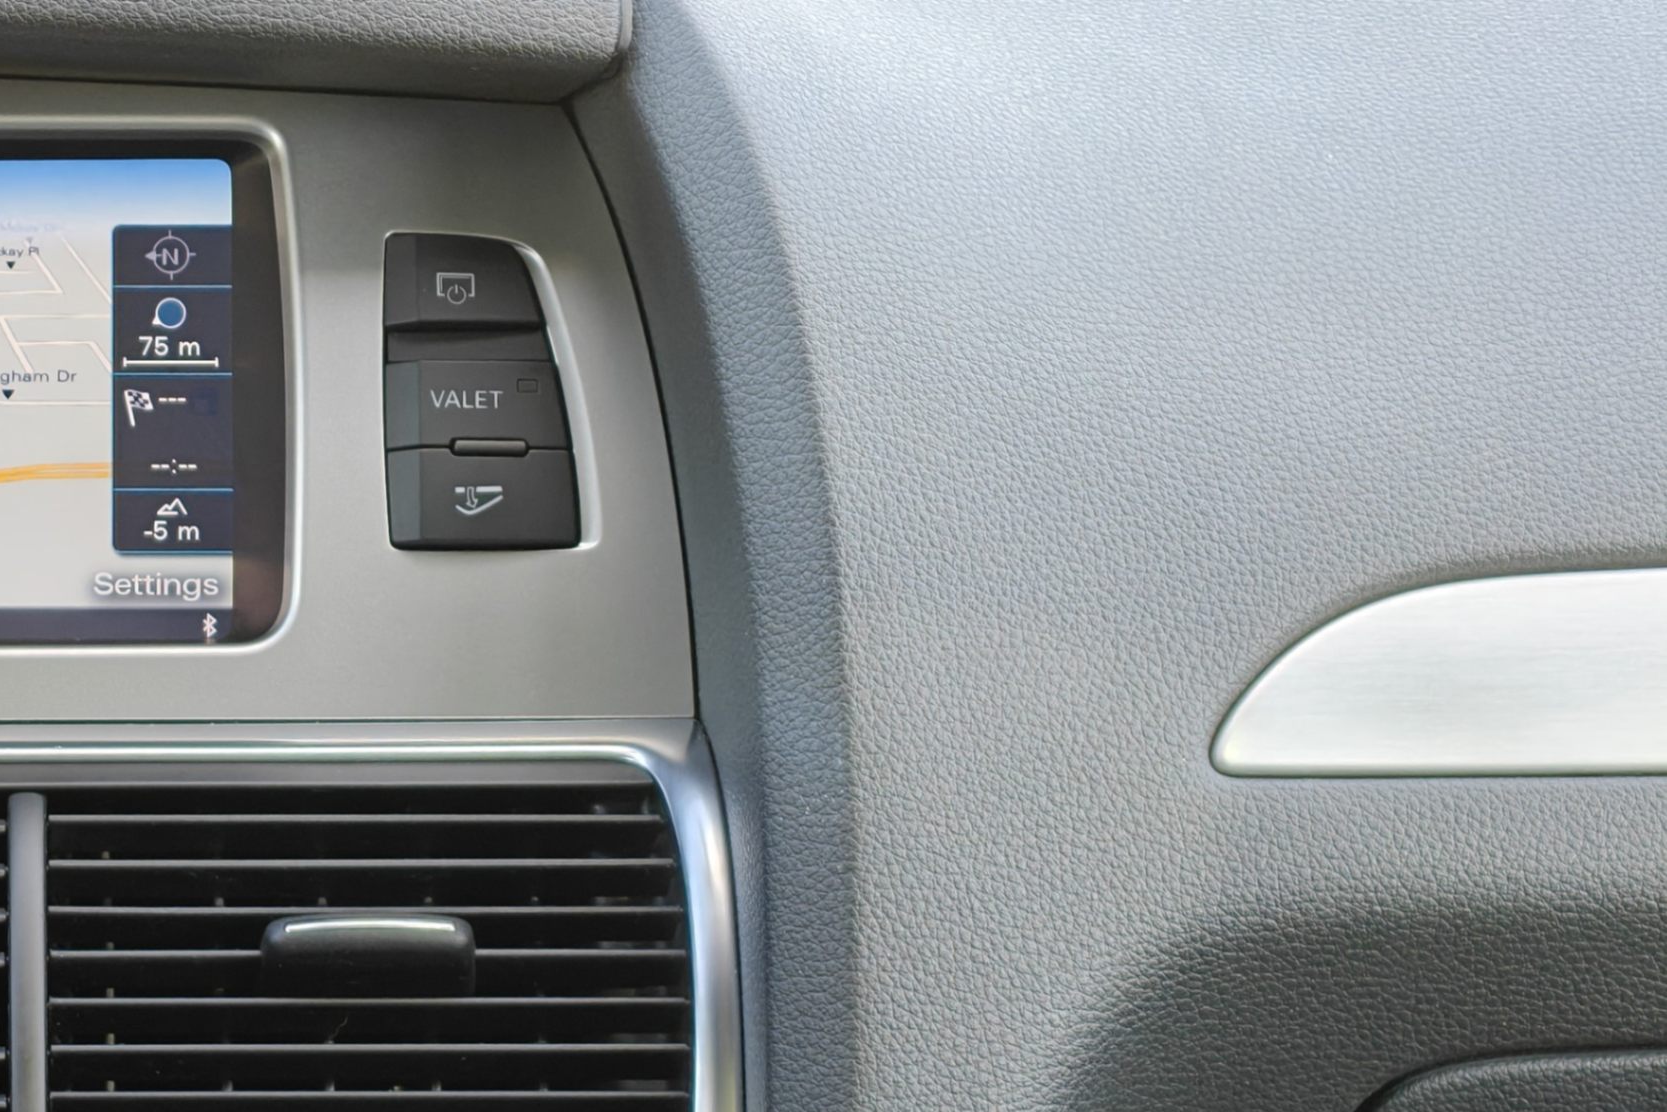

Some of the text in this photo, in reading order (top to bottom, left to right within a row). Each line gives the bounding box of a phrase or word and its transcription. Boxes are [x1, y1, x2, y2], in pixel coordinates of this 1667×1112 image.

[162, 248, 179, 266] N
[138, 336, 201, 356] 75 m
[57, 370, 77, 383] Dr
[430, 389, 504, 409] VALET
[143, 520, 200, 541] -5 m
[93, 572, 220, 602] Settings
